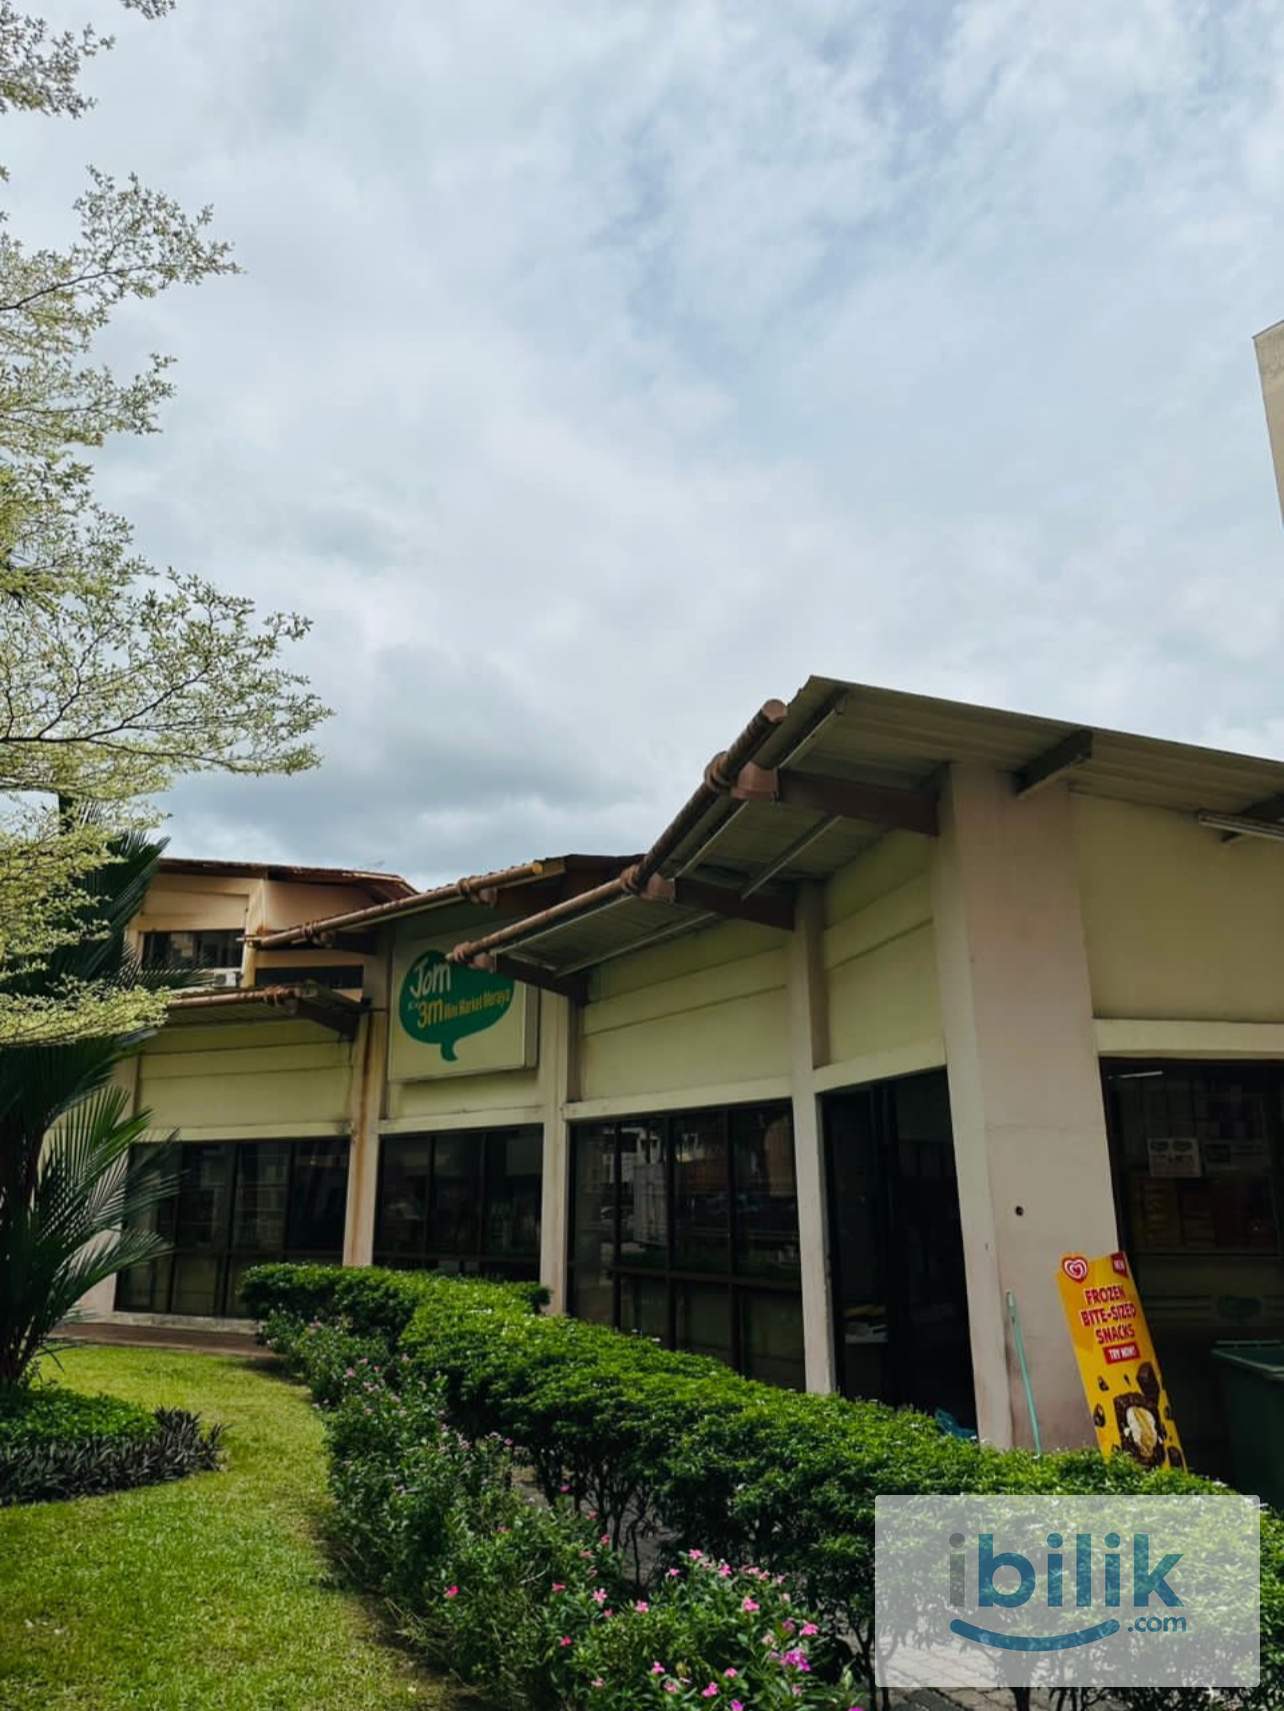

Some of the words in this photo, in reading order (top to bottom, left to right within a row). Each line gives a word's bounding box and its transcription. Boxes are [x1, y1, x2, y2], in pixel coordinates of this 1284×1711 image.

[1084, 1285, 1126, 1305] FROZEN
[1080, 1303, 1137, 1327] BITE-SIZED
[1095, 1324, 1135, 1344] SNACKS
